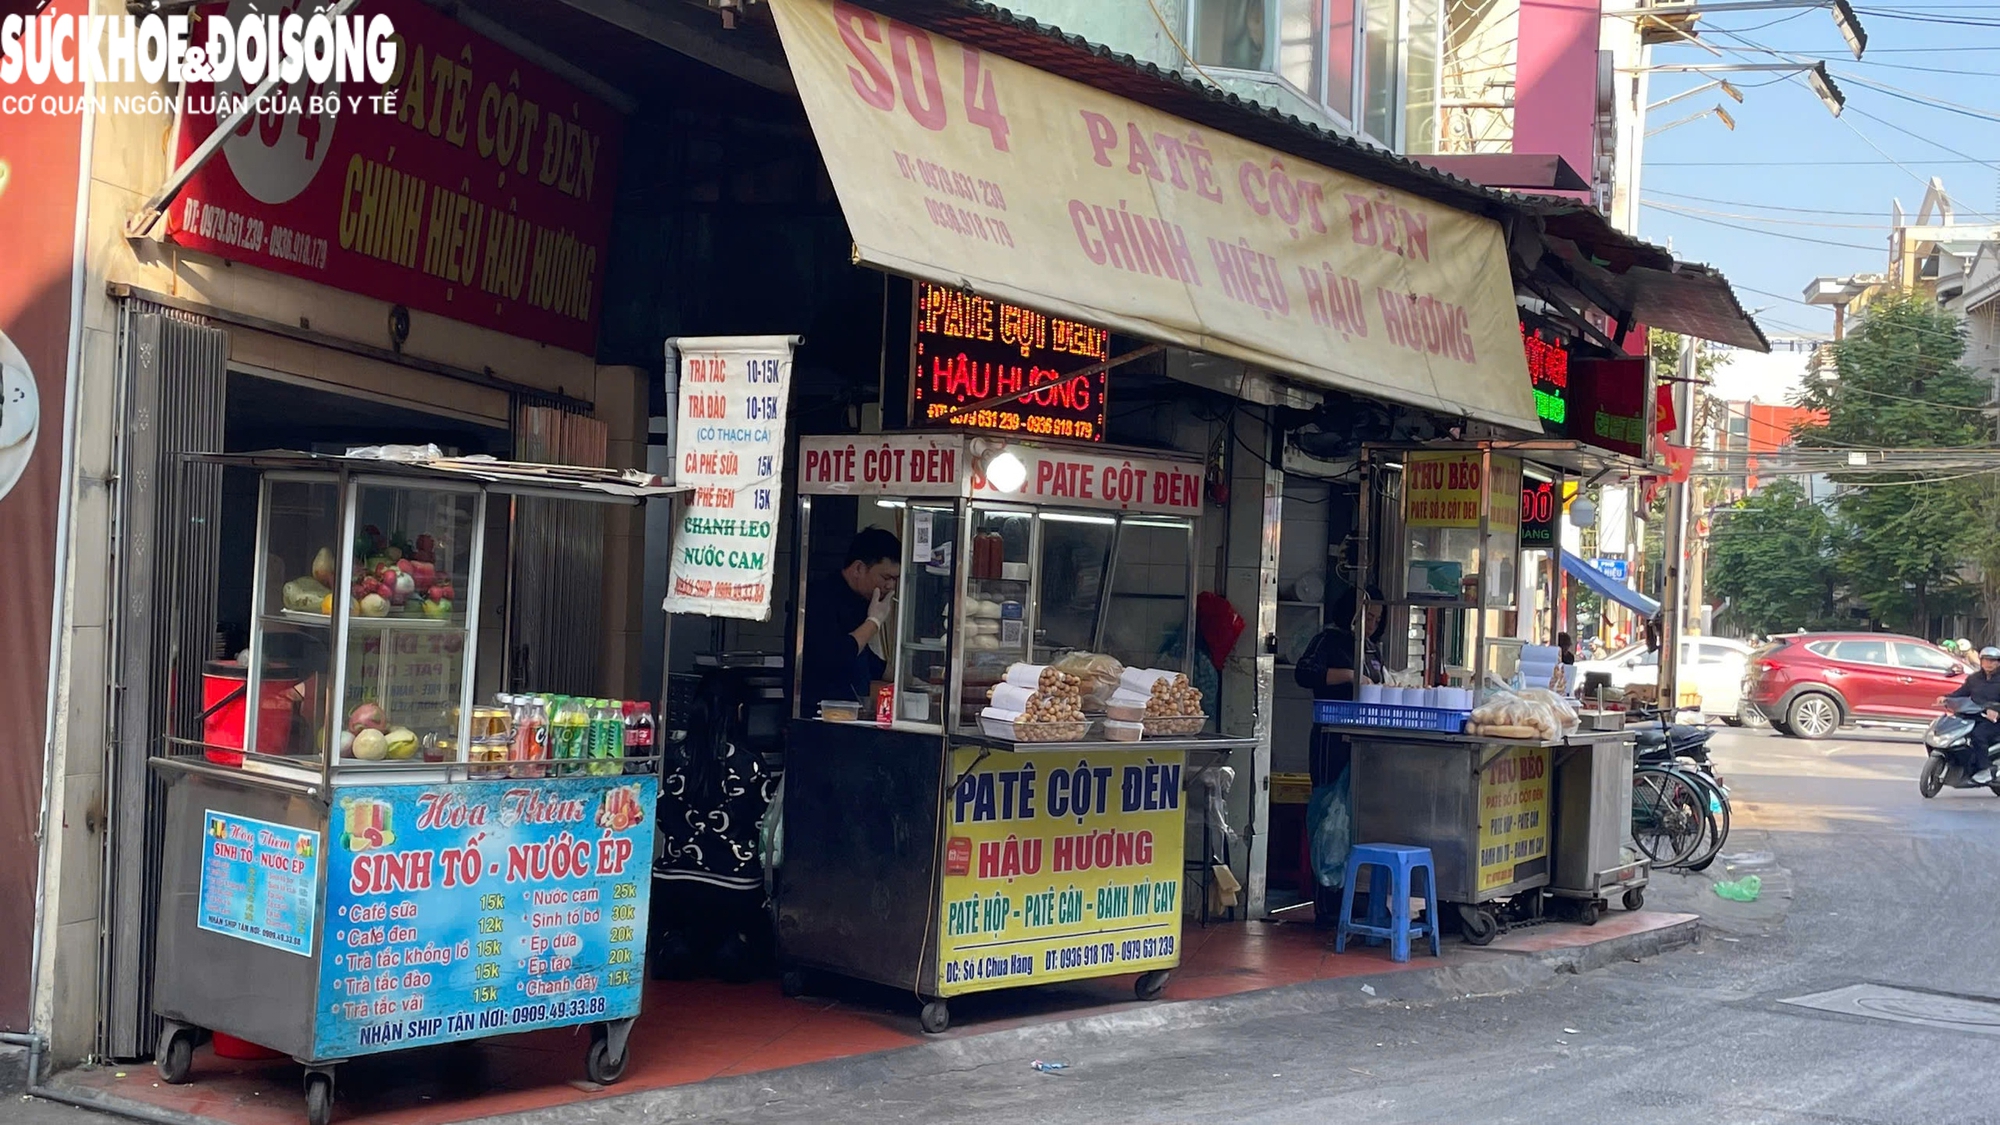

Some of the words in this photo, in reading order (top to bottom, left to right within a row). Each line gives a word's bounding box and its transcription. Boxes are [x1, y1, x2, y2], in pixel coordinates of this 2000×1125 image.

[477, 68, 539, 189] CỘT
[538, 102, 600, 203] ĐÈN
[1079, 109, 1223, 204] PATÊ
[1238, 157, 1328, 240] CỘT
[1344, 187, 1430, 263] ĐÈN
[339, 146, 427, 269] CHÍNH
[423, 177, 484, 301] HIỆU
[481, 197, 530, 316] HẬU
[528, 226, 597, 322] HƯƠNG
[1068, 199, 1202, 287] CHÍNH
[1207, 237, 1290, 321] HIỆU
[1299, 261, 1368, 343] HẬU
[1377, 286, 1477, 364] HƯƠNG
[747, 359, 779, 383] 10-15K
[933, 352, 990, 402] HẬU
[997, 364, 1089, 410] HƯƠNG
[689, 390, 705, 418] TRÀ
[746, 396, 778, 419] 10-15K
[999, 412, 1019, 430] 239
[717, 428, 752, 444] THẠCH
[757, 455, 773, 476] 15K
[805, 444, 856, 482] PATÊ
[863, 442, 905, 489] CỘT
[909, 443, 955, 483] ĐÈN
[1411, 462, 1444, 490] THU
[1448, 455, 1480, 490] BÉO
[1102, 460, 1147, 509] CỘT
[1153, 466, 1200, 507] ĐÈN
[754, 489, 771, 509] 15K
[1441, 501, 1446, 519] 2
[684, 517, 736, 537] CHANH
[739, 520, 771, 538] LEO
[684, 544, 725, 567] NƯỚC
[728, 551, 765, 570] CAM
[1520, 749, 1544, 781] BÉO
[954, 762, 1036, 824] PATÊ
[1047, 760, 1112, 825] CỘT
[1121, 758, 1181, 813] ĐÈN
[215, 843, 237, 859] SINH
[240, 844, 253, 862] TỐ
[261, 851, 289, 870] NƯỚC
[292, 855, 305, 874] ÉP
[351, 849, 432, 896] SINH
[441, 831, 486, 887] TỐ
[506, 831, 590, 881] NƯỚC
[596, 829, 632, 875] ÉP
[978, 834, 1042, 883] HẬU
[1053, 828, 1153, 872] HƯƠNG
[480, 894, 505, 911] 15k
[534, 889, 568, 905] Nước
[572, 889, 599, 902] cam
[613, 884, 637, 899] 25k
[351, 904, 386, 922] Café
[390, 902, 417, 919] sữa
[532, 913, 562, 928] Sinh
[567, 908, 580, 925] tố
[584, 908, 601, 923] bơ
[611, 905, 635, 921] 30k
[948, 893, 978, 935] PATÊ
[983, 891, 1010, 938] HỘP
[1025, 886, 1054, 927] PATÊ
[1058, 885, 1082, 924] CÂN
[1097, 881, 1129, 920] BÁNH
[1154, 881, 1177, 913] CAY
[389, 926, 417, 942] đen
[478, 917, 503, 933] 12k
[609, 927, 633, 943] 20k
[476, 940, 502, 956] 15k
[531, 932, 549, 953] Ép
[553, 932, 577, 949] dứa
[347, 953, 372, 971] Trà
[377, 947, 399, 966] tắc
[405, 942, 451, 965] khổng
[529, 954, 547, 976] Ép
[551, 955, 572, 971] táo
[608, 949, 631, 965] 20k
[963, 957, 975, 980] Số
[977, 960, 983, 978] 4
[1011, 953, 1033, 975] Hàng
[1060, 947, 1082, 968] 0936
[1083, 944, 1099, 966] 918
[1101, 943, 1115, 964] 179
[1121, 939, 1141, 961] 0979
[1143, 938, 1157, 958] 631
[1158, 935, 1174, 955] 239
[474, 963, 499, 980] 15k
[608, 970, 630, 987] 15k
[345, 976, 371, 995] Trà
[375, 971, 399, 991] tắc
[403, 971, 432, 988] đào
[526, 979, 570, 996] Chanh
[344, 1002, 369, 1018] Trà
[373, 996, 397, 1015] tắc
[401, 993, 424, 1011] vải
[473, 986, 498, 1003] 15k
[359, 1019, 403, 1046] NHẬN
[408, 1018, 442, 1039] SHIP
[447, 1011, 475, 1036] TẬN
[479, 1008, 508, 1029] NƠI:
[512, 997, 606, 1024] 0909.49.33.88
